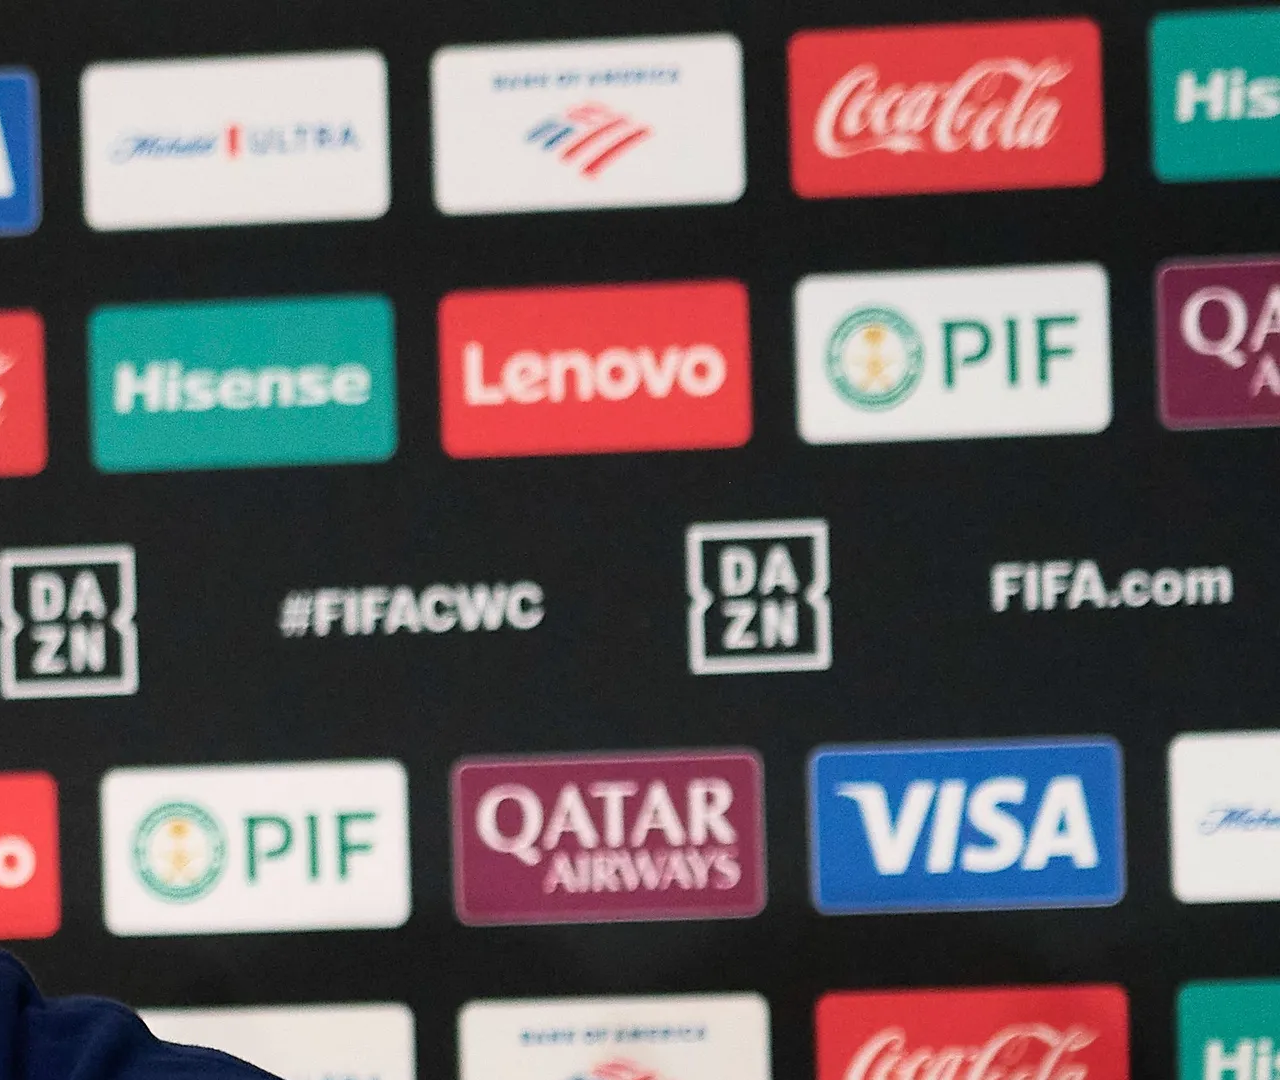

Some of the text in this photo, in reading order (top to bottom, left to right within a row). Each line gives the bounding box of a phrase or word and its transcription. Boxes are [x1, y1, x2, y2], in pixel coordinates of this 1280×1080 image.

[463, 343, 726, 405] Lenovo
[941, 315, 1078, 389] PIF
[113, 361, 371, 414] Hisense
[29, 569, 108, 622] DA
[720, 546, 798, 596] DA
[991, 560, 1232, 612] FIFA.com
[280, 582, 543, 636] #FIFACWC
[722, 603, 800, 650] ZN
[33, 625, 105, 673] ZN
[244, 811, 376, 882] PIF
[477, 779, 739, 867] QATAR
[838, 776, 1098, 875] VISA
